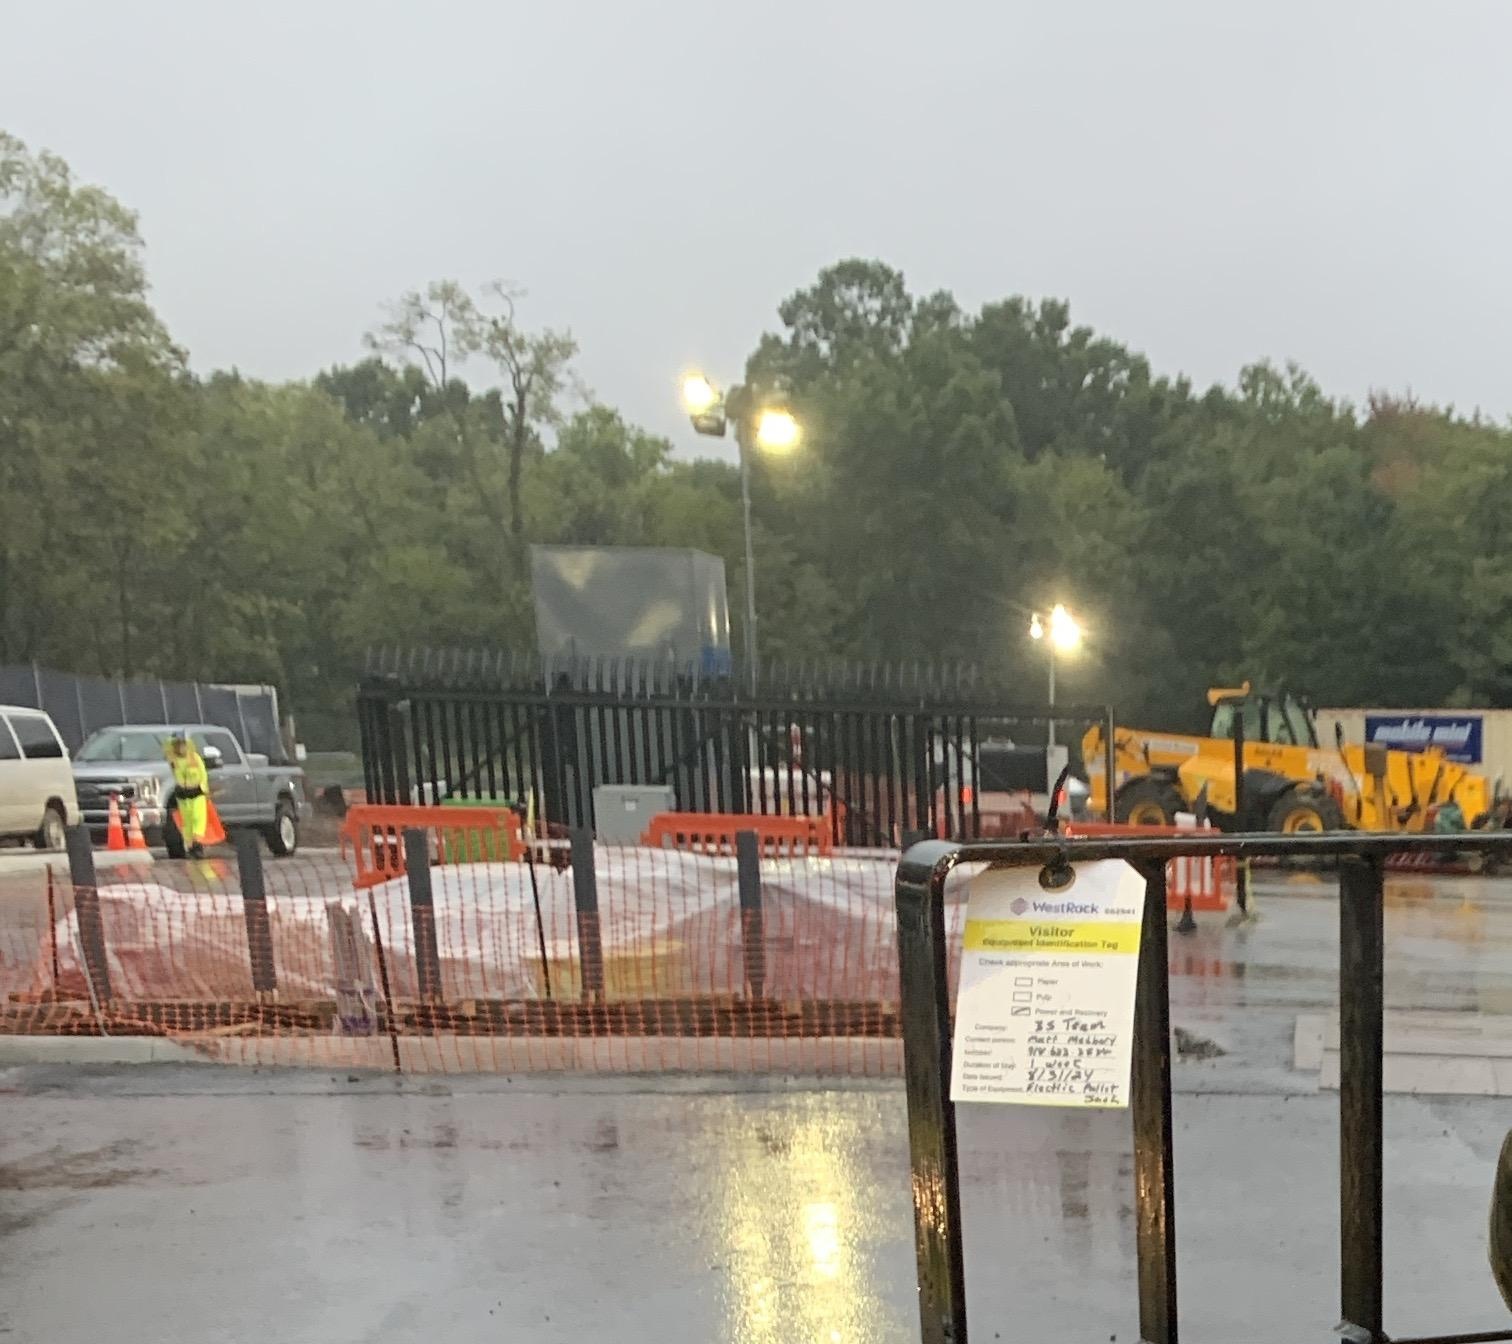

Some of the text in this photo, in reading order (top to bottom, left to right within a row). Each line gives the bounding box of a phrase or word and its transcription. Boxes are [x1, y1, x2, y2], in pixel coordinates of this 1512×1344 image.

[1033, 902, 1099, 914] WestRock
[1029, 926, 1074, 937] Visitor
[1035, 938, 1098, 948] Identification
[1101, 940, 1119, 950] Tag
[1051, 959, 1070, 968] Area
[1072, 959, 1080, 968] of
[1063, 1017, 1107, 1031] Team
